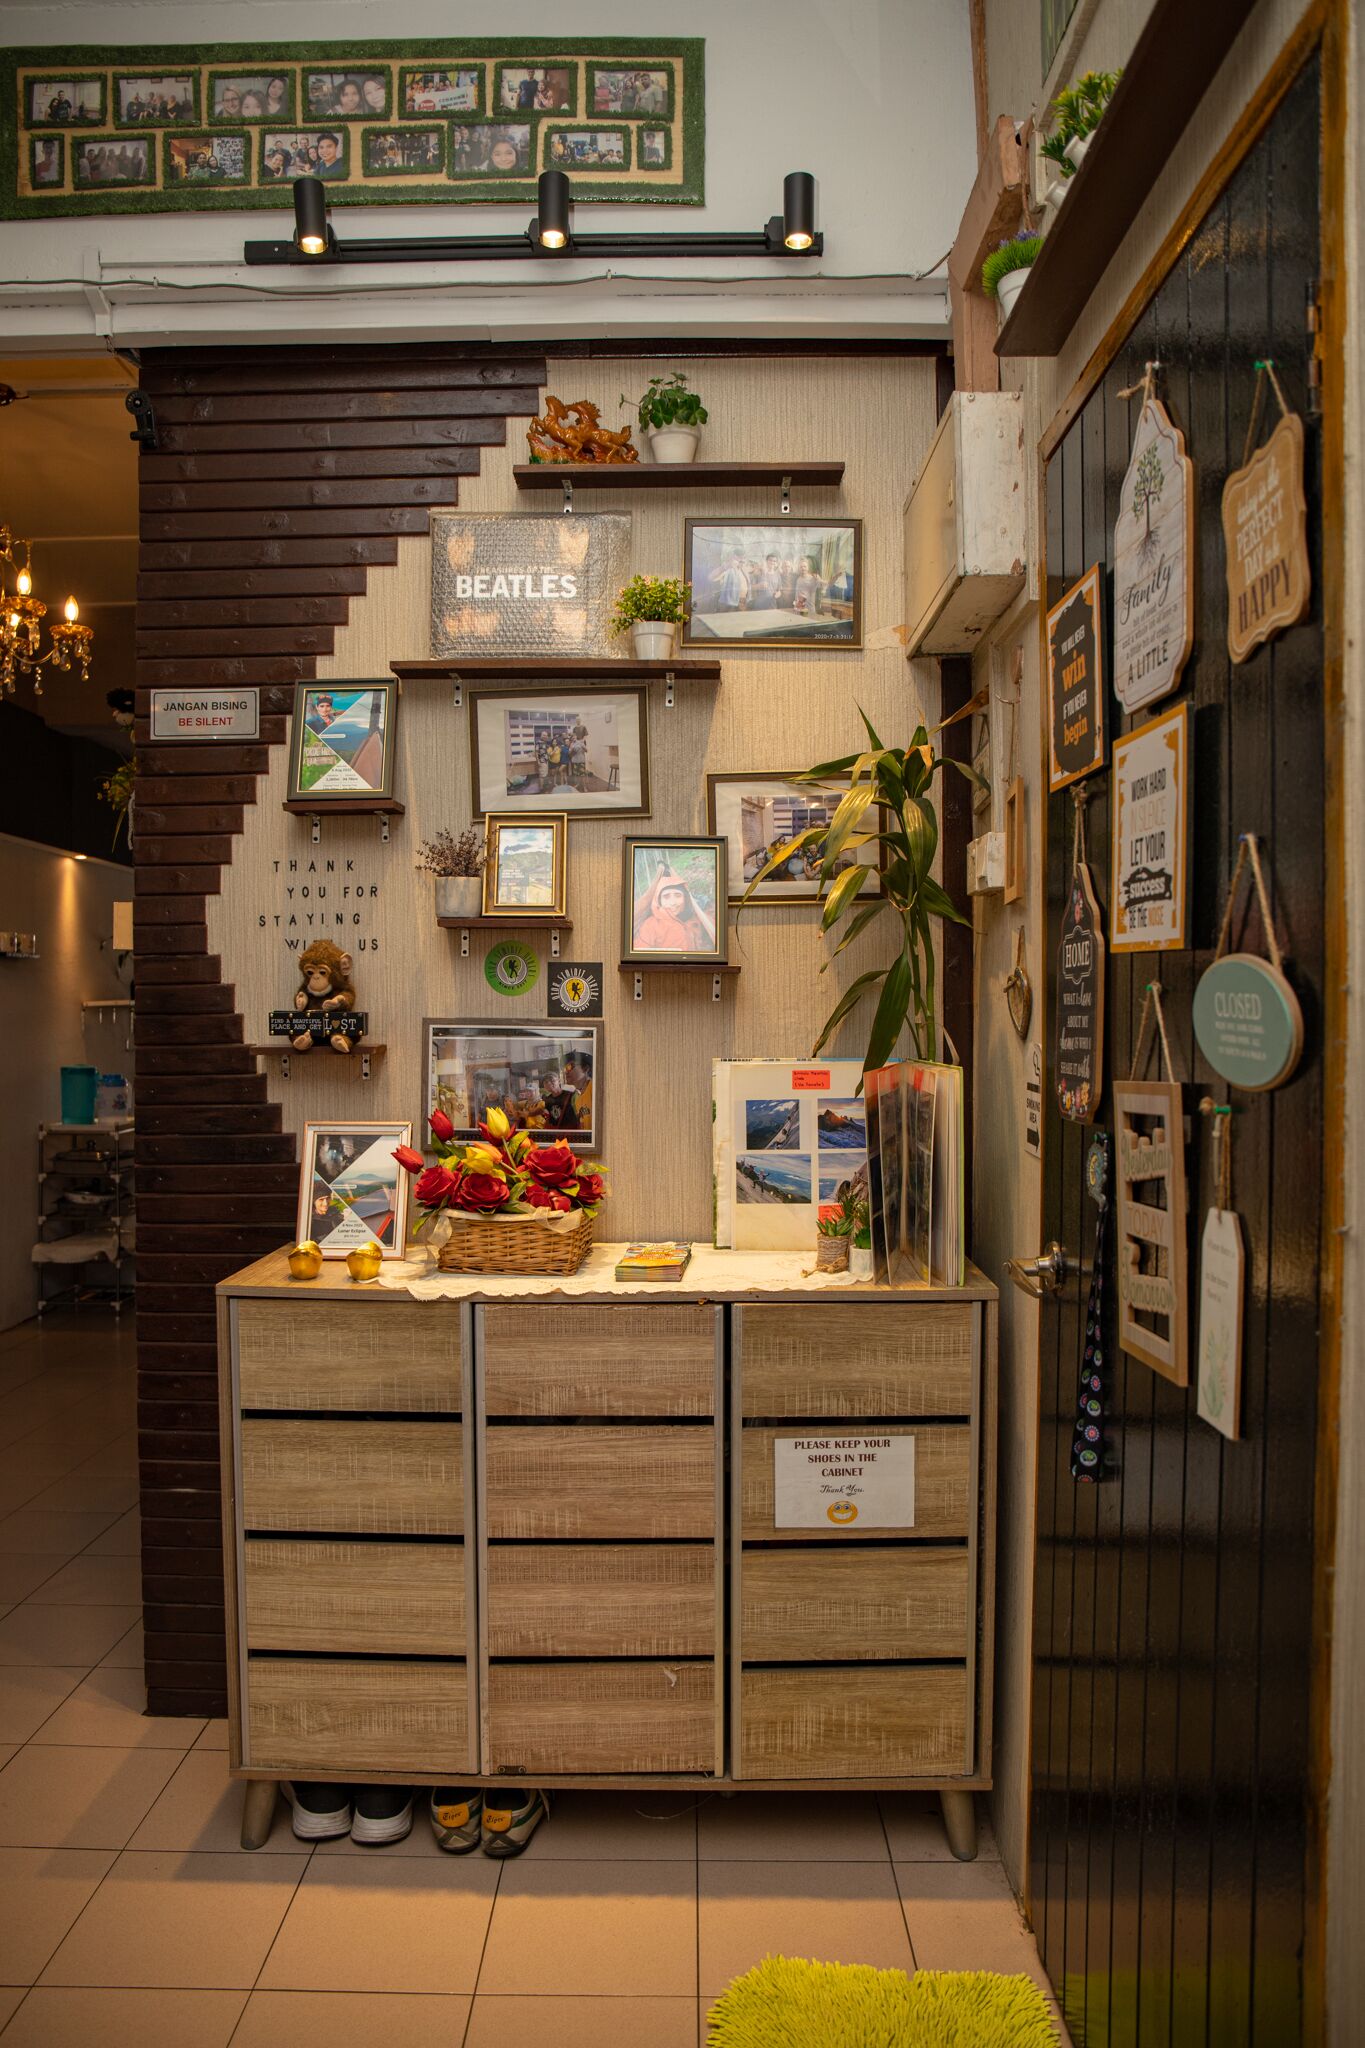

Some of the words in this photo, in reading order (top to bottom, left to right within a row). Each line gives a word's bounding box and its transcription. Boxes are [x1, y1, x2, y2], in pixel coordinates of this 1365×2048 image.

[1236, 488, 1284, 561] PERFECT
[1245, 543, 1265, 586] DAY
[456, 575, 577, 598] BEATLES
[1120, 553, 1178, 625] Family
[1238, 552, 1291, 634] HAPPY
[1074, 624, 1085, 647] NEVER
[1062, 649, 1086, 692] win
[1128, 663, 1134, 686] A
[1136, 640, 1168, 680] LITTLE
[163, 702, 208, 712] JANGAN
[211, 701, 248, 710] BISING
[1074, 688, 1087, 713] NEVER
[178, 718, 193, 726] BE
[195, 716, 234, 726] SILENT
[1064, 714, 1088, 746] begin
[1131, 776, 1149, 802] WORK
[1150, 768, 1166, 795] HARD
[1138, 796, 1167, 833] SILENCE
[1130, 837, 1144, 867] LET
[1144, 830, 1166, 863] YOUR
[273, 860, 354, 872] THANK
[287, 886, 326, 898] YOU
[344, 886, 378, 898] FOR
[1129, 876, 1166, 899] success
[259, 913, 360, 926] STAYING
[1128, 906, 1136, 929] BE
[1137, 904, 1148, 928] THE
[358, 938, 378, 951] US
[1065, 941, 1090, 968] HOME
[1063, 992, 1076, 1006] WHAT
[1078, 982, 1092, 1006] love
[1214, 992, 1262, 1020] CLOSED
[560, 1003, 578, 1013] SINCE
[1067, 1016, 1080, 1028] ABOUT
[1081, 1016, 1089, 1028] MY
[1060, 1062, 1072, 1075] SHARE
[1072, 1063, 1078, 1076] IT
[1078, 1054, 1090, 1079] with
[1121, 1134, 1174, 1190] Yesterday
[1128, 1206, 1164, 1242] TODAY
[794, 1440, 831, 1450] PLEASE
[834, 1440, 860, 1449] KEEP
[864, 1439, 890, 1448] YOUR
[808, 1454, 841, 1464] SHOES
[844, 1454, 854, 1462] IN
[858, 1454, 878, 1462] THE
[822, 1468, 864, 1477] CABINET
[820, 1484, 845, 1494] Thank
[443, 1811, 462, 1820] Tiger
[486, 1814, 505, 1824] Tiger
